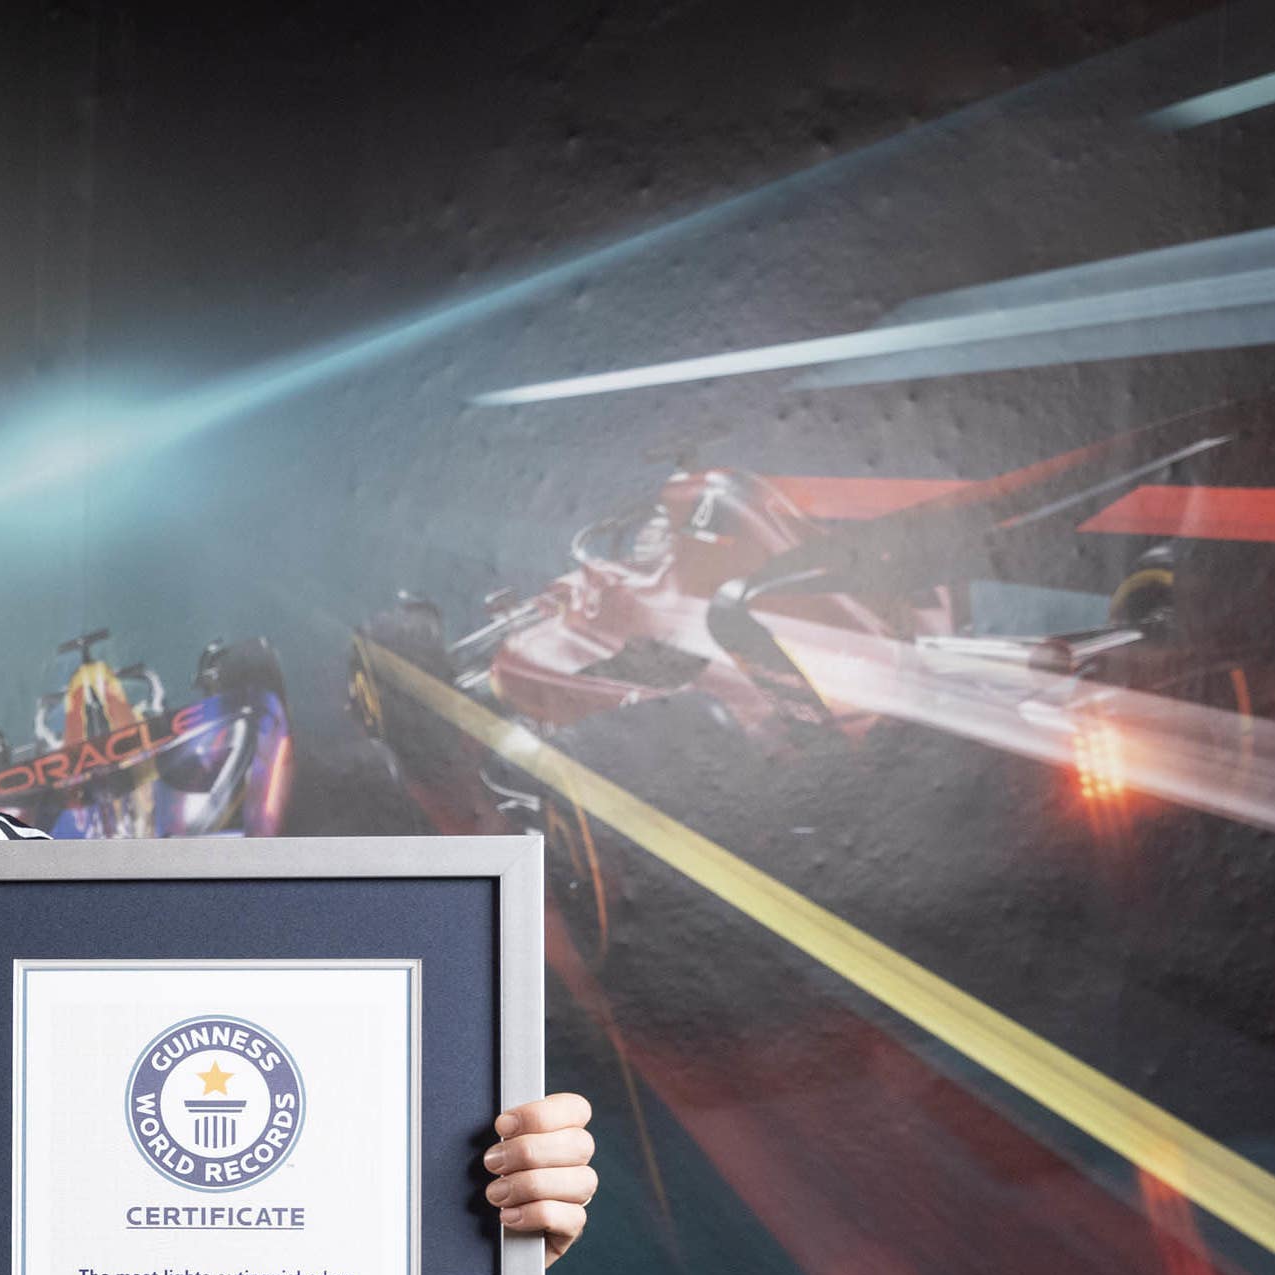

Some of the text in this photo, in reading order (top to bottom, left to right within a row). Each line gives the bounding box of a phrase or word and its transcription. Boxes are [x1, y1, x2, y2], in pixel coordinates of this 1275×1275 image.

[151, 1026, 281, 1073] GUINNESS
[136, 1092, 295, 1183] WORLD RECORDS
[126, 1206, 306, 1227] CERTIFICATE
